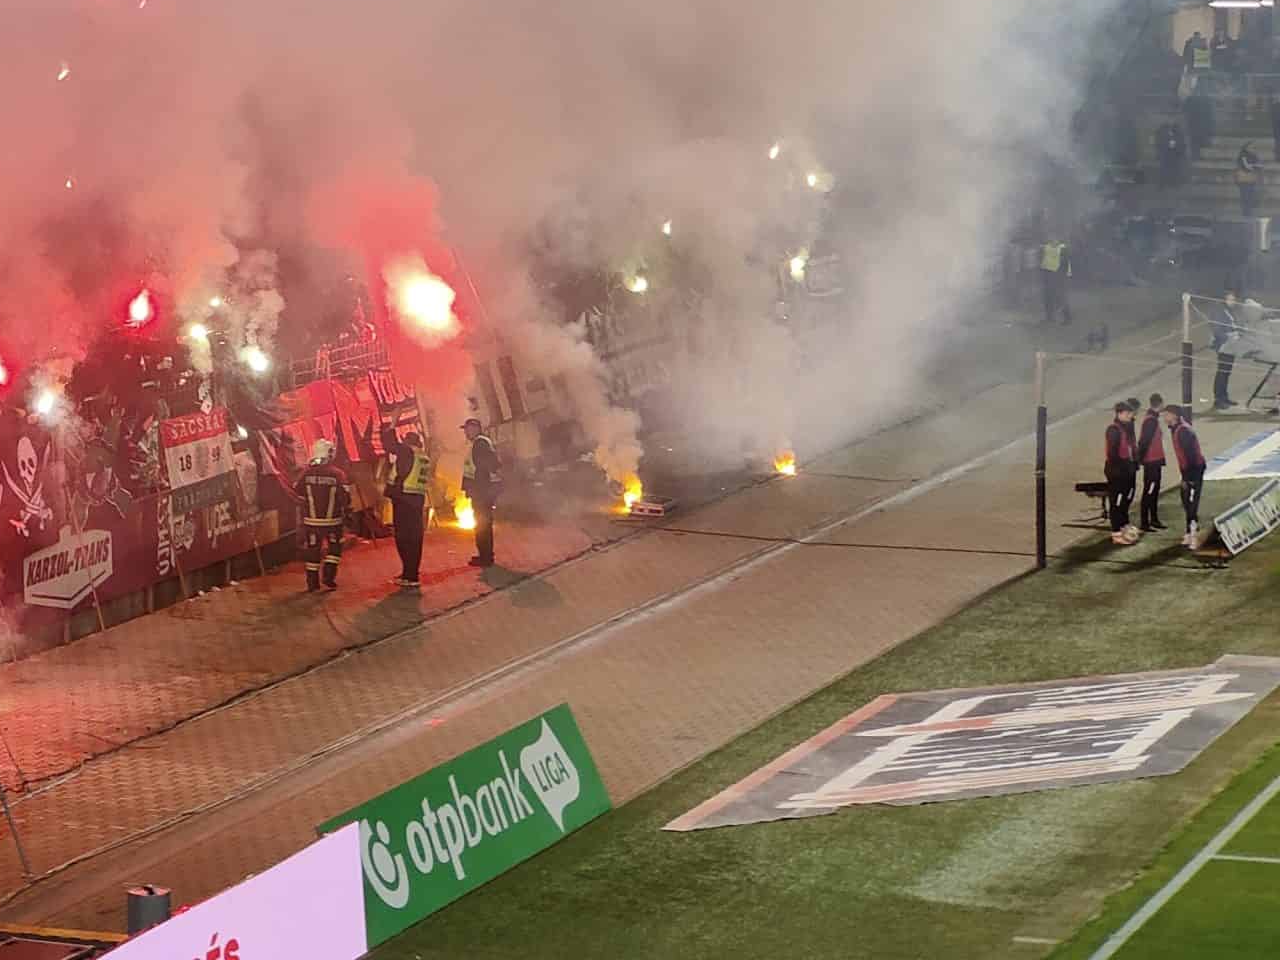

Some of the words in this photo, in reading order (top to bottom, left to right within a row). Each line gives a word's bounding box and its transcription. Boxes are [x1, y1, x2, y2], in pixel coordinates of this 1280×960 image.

[179, 454, 193, 472] 18
[532, 752, 570, 792] LIGA
[406, 750, 534, 880] otpbank
